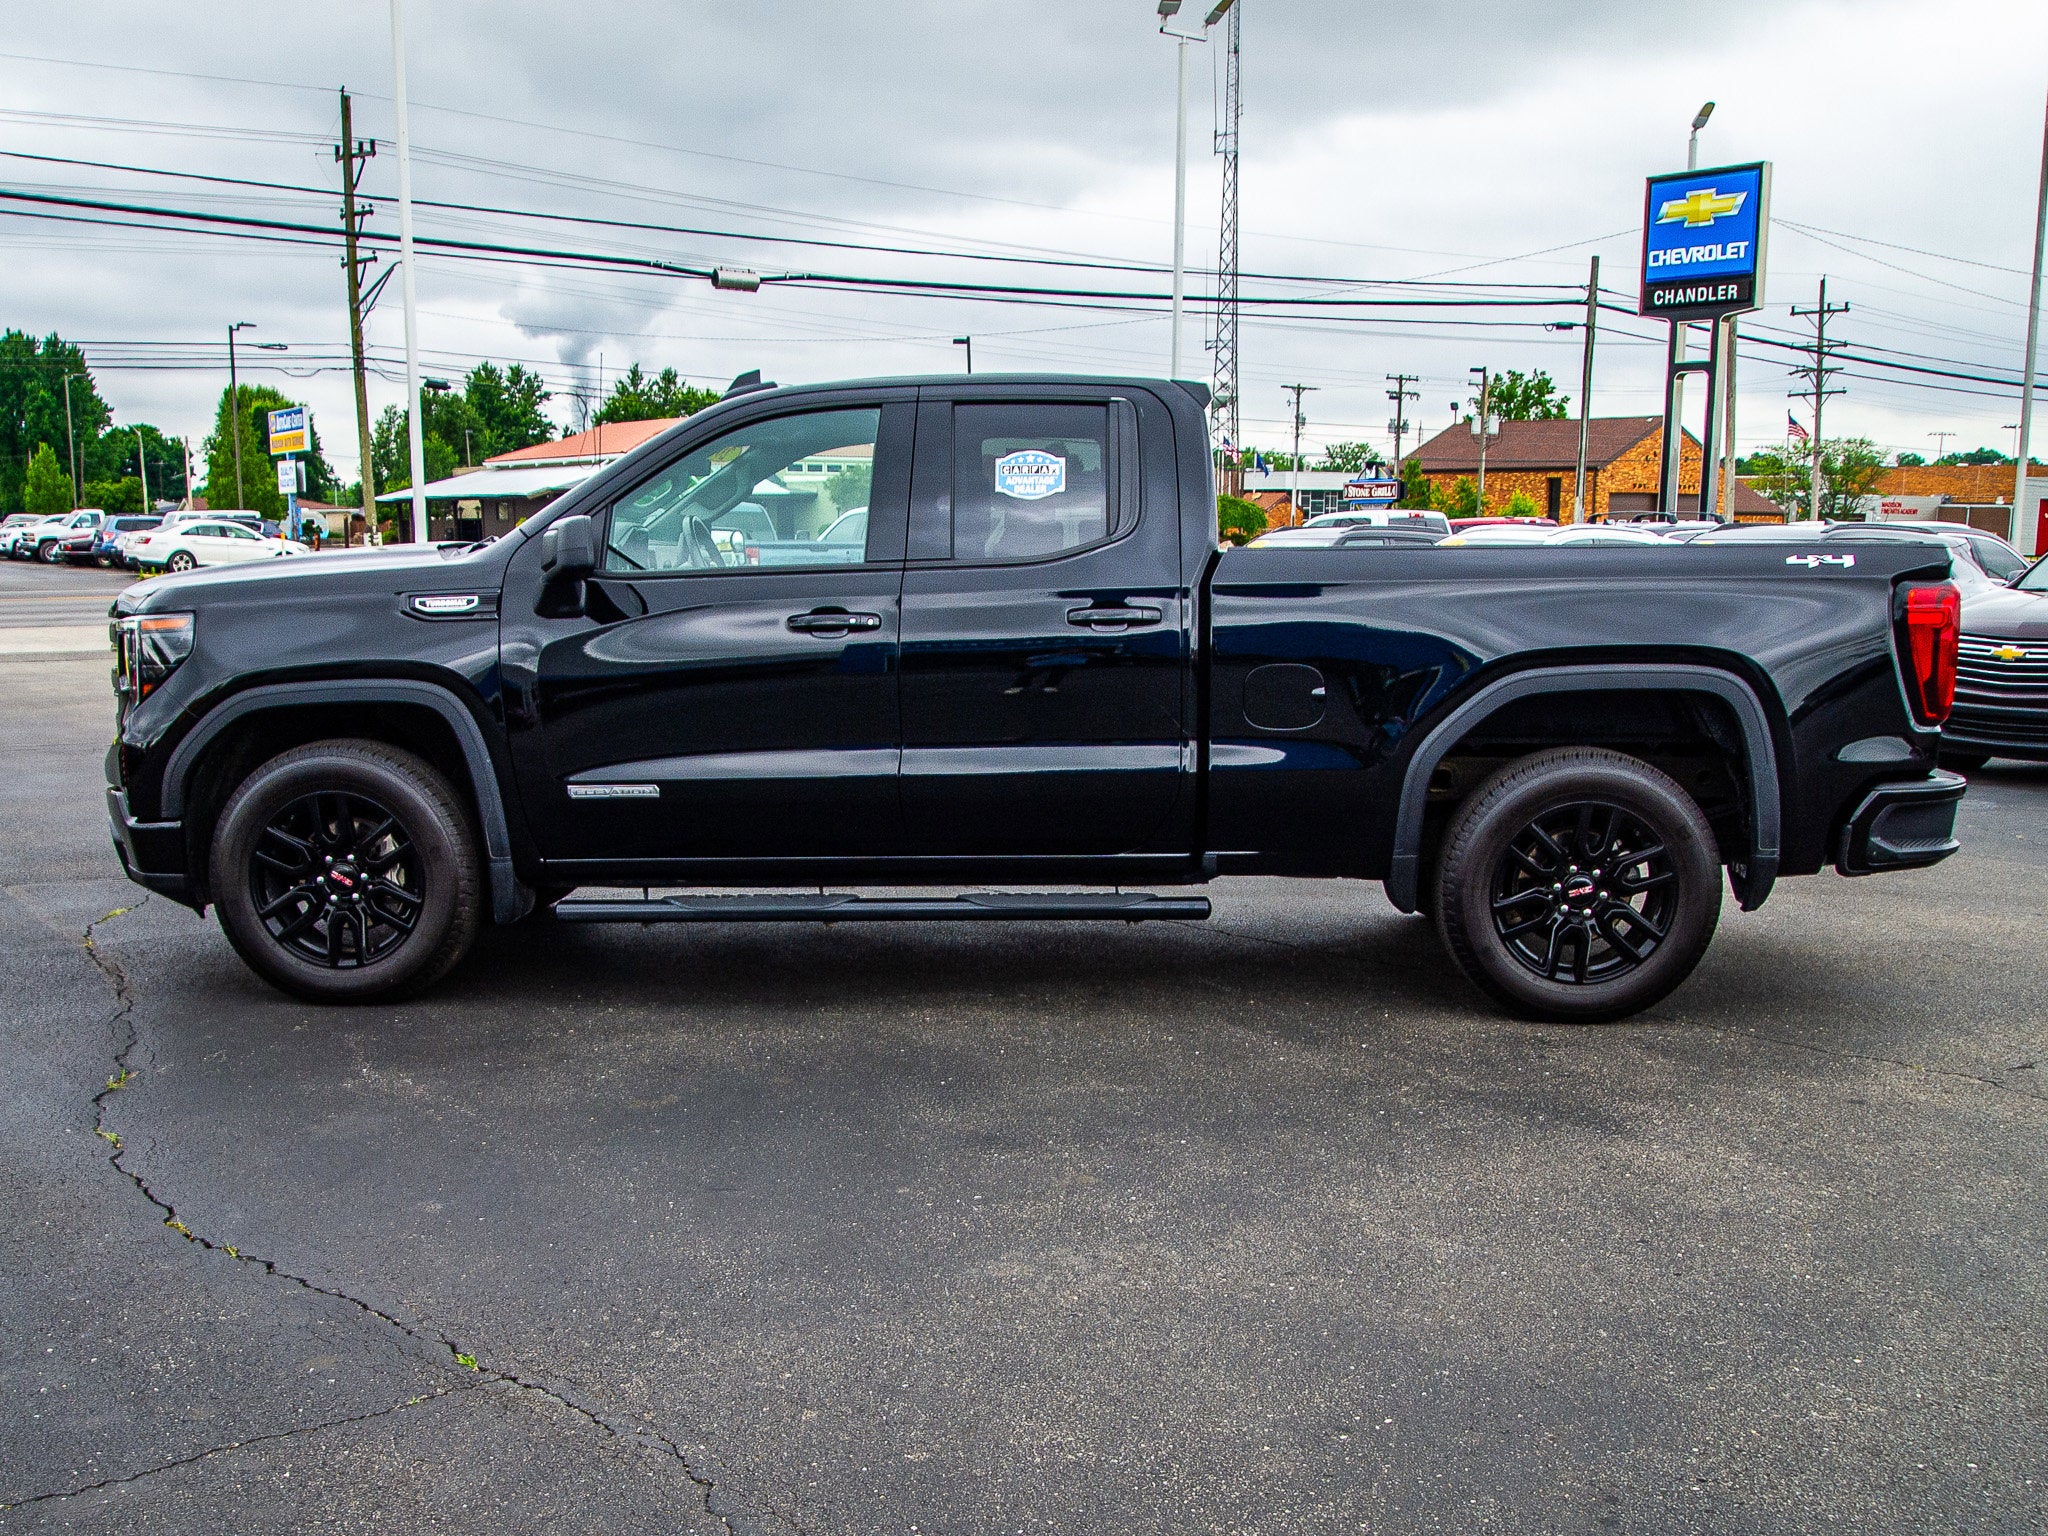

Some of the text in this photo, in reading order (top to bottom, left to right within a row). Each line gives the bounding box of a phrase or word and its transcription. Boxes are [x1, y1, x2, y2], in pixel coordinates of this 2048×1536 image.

[1648, 241, 1749, 267] CHEVROLET
[1653, 284, 1738, 305] CHANDLER
[1002, 465, 1058, 474] CARFAX
[1006, 475, 1055, 485] ADVANTAGE
[1014, 485, 1046, 494] DEALER
[1348, 485, 1392, 498] STONE GRILL
[570, 786, 655, 796] ELEVATION
[1568, 884, 1594, 897] GMC
